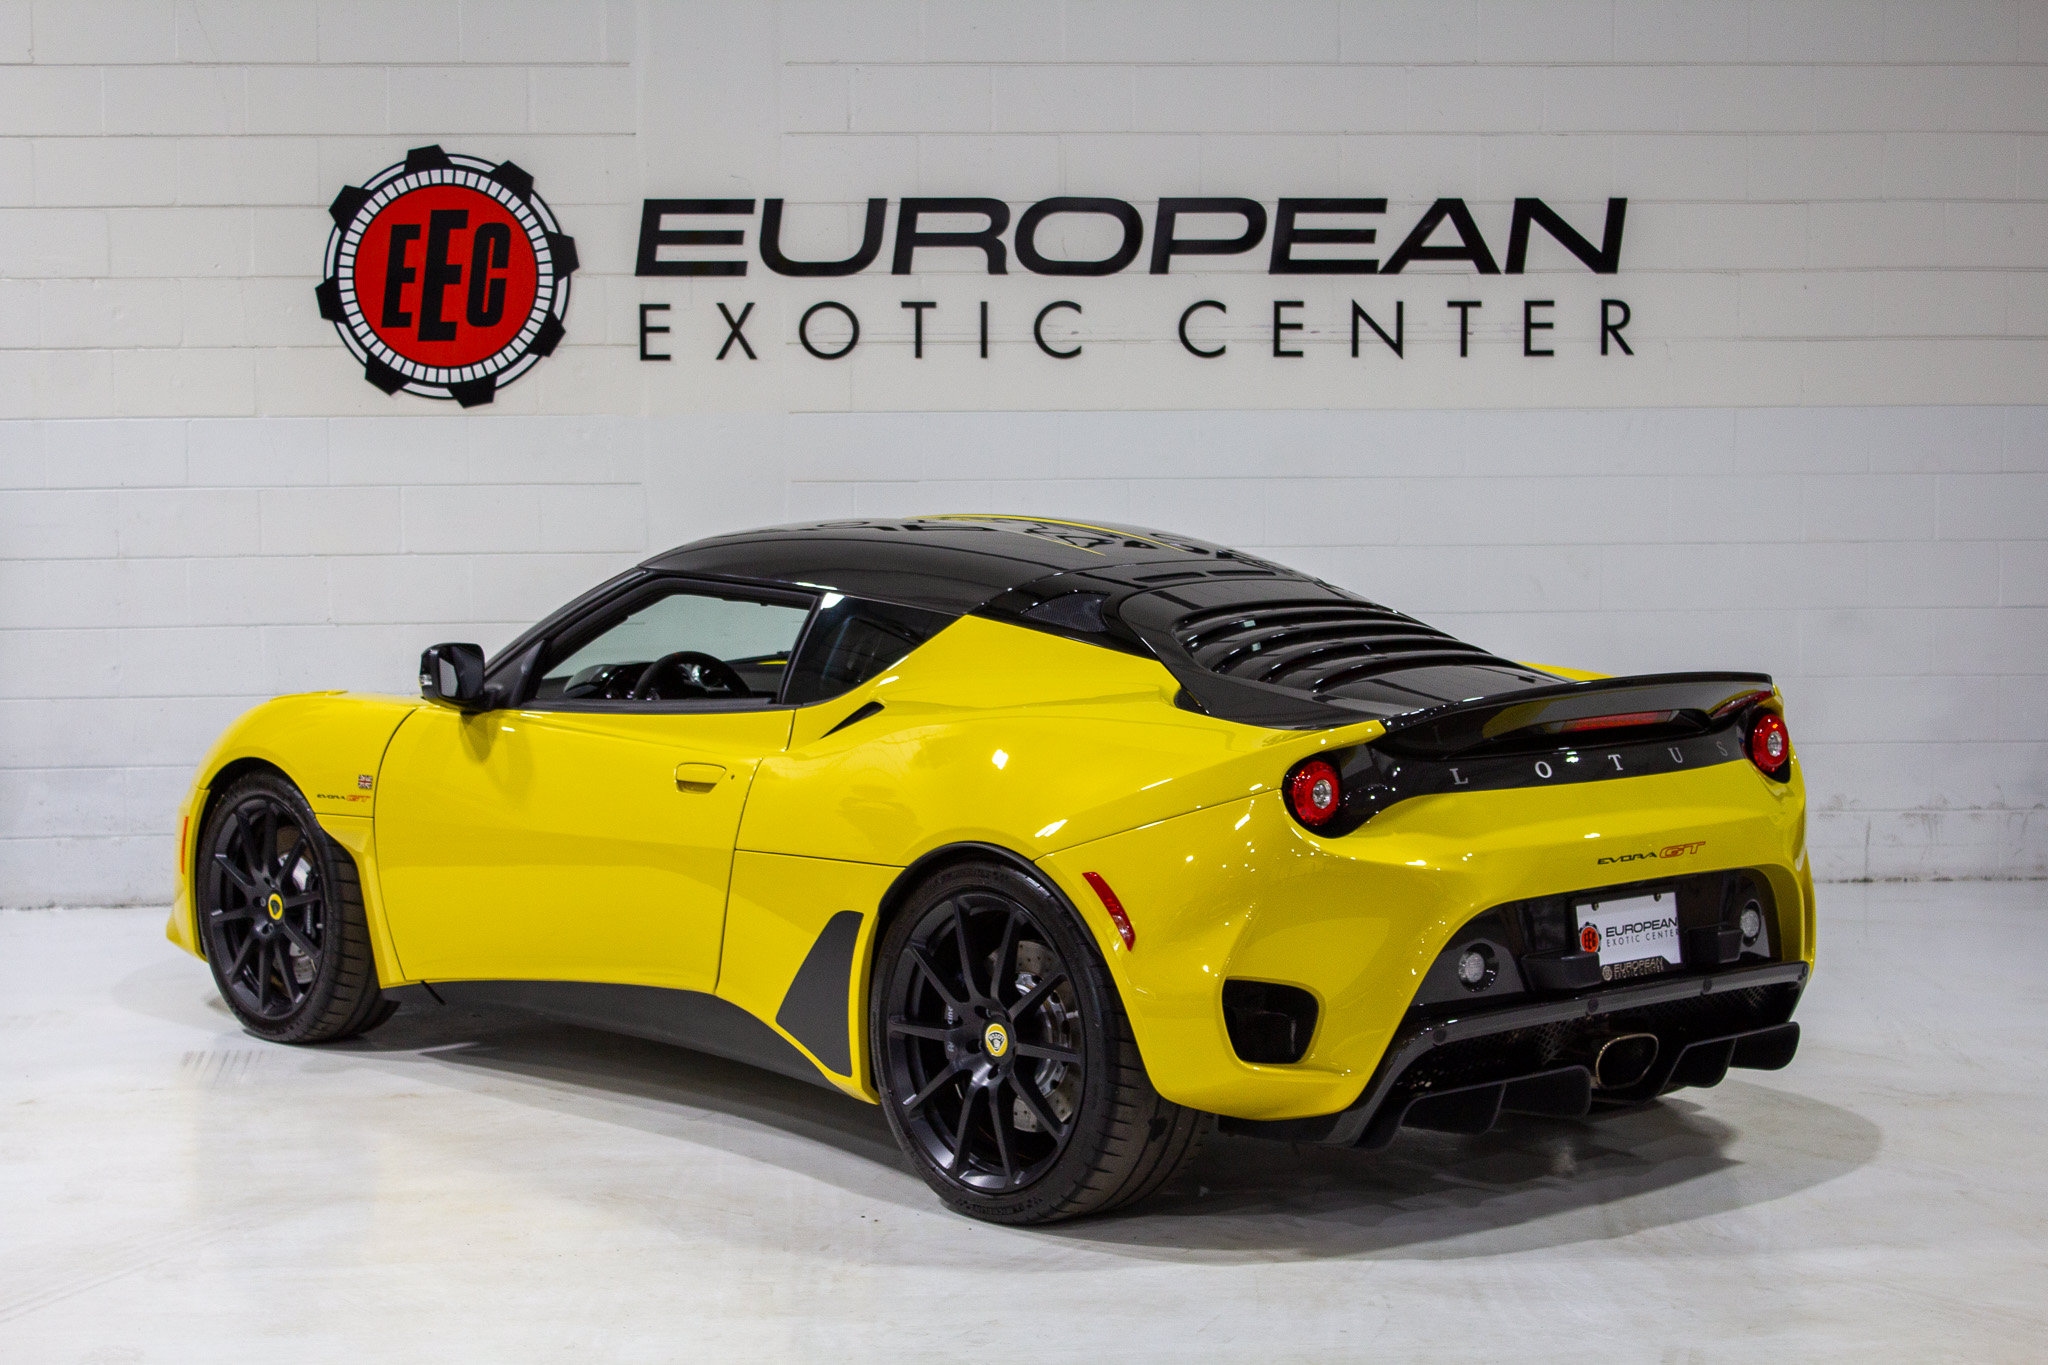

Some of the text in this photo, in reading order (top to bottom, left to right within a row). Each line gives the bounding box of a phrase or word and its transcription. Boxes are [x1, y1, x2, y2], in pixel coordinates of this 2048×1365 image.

[635, 198, 1628, 277] EUROPEAN
[381, 209, 511, 342] EEC
[638, 298, 1635, 360] EXOTIC CENTER
[1449, 740, 1729, 786] LOTUS
[1597, 841, 1706, 865] EVORA GT
[1606, 917, 1678, 937] EUROPEAN
[1606, 934, 1641, 948] EXOTIC
